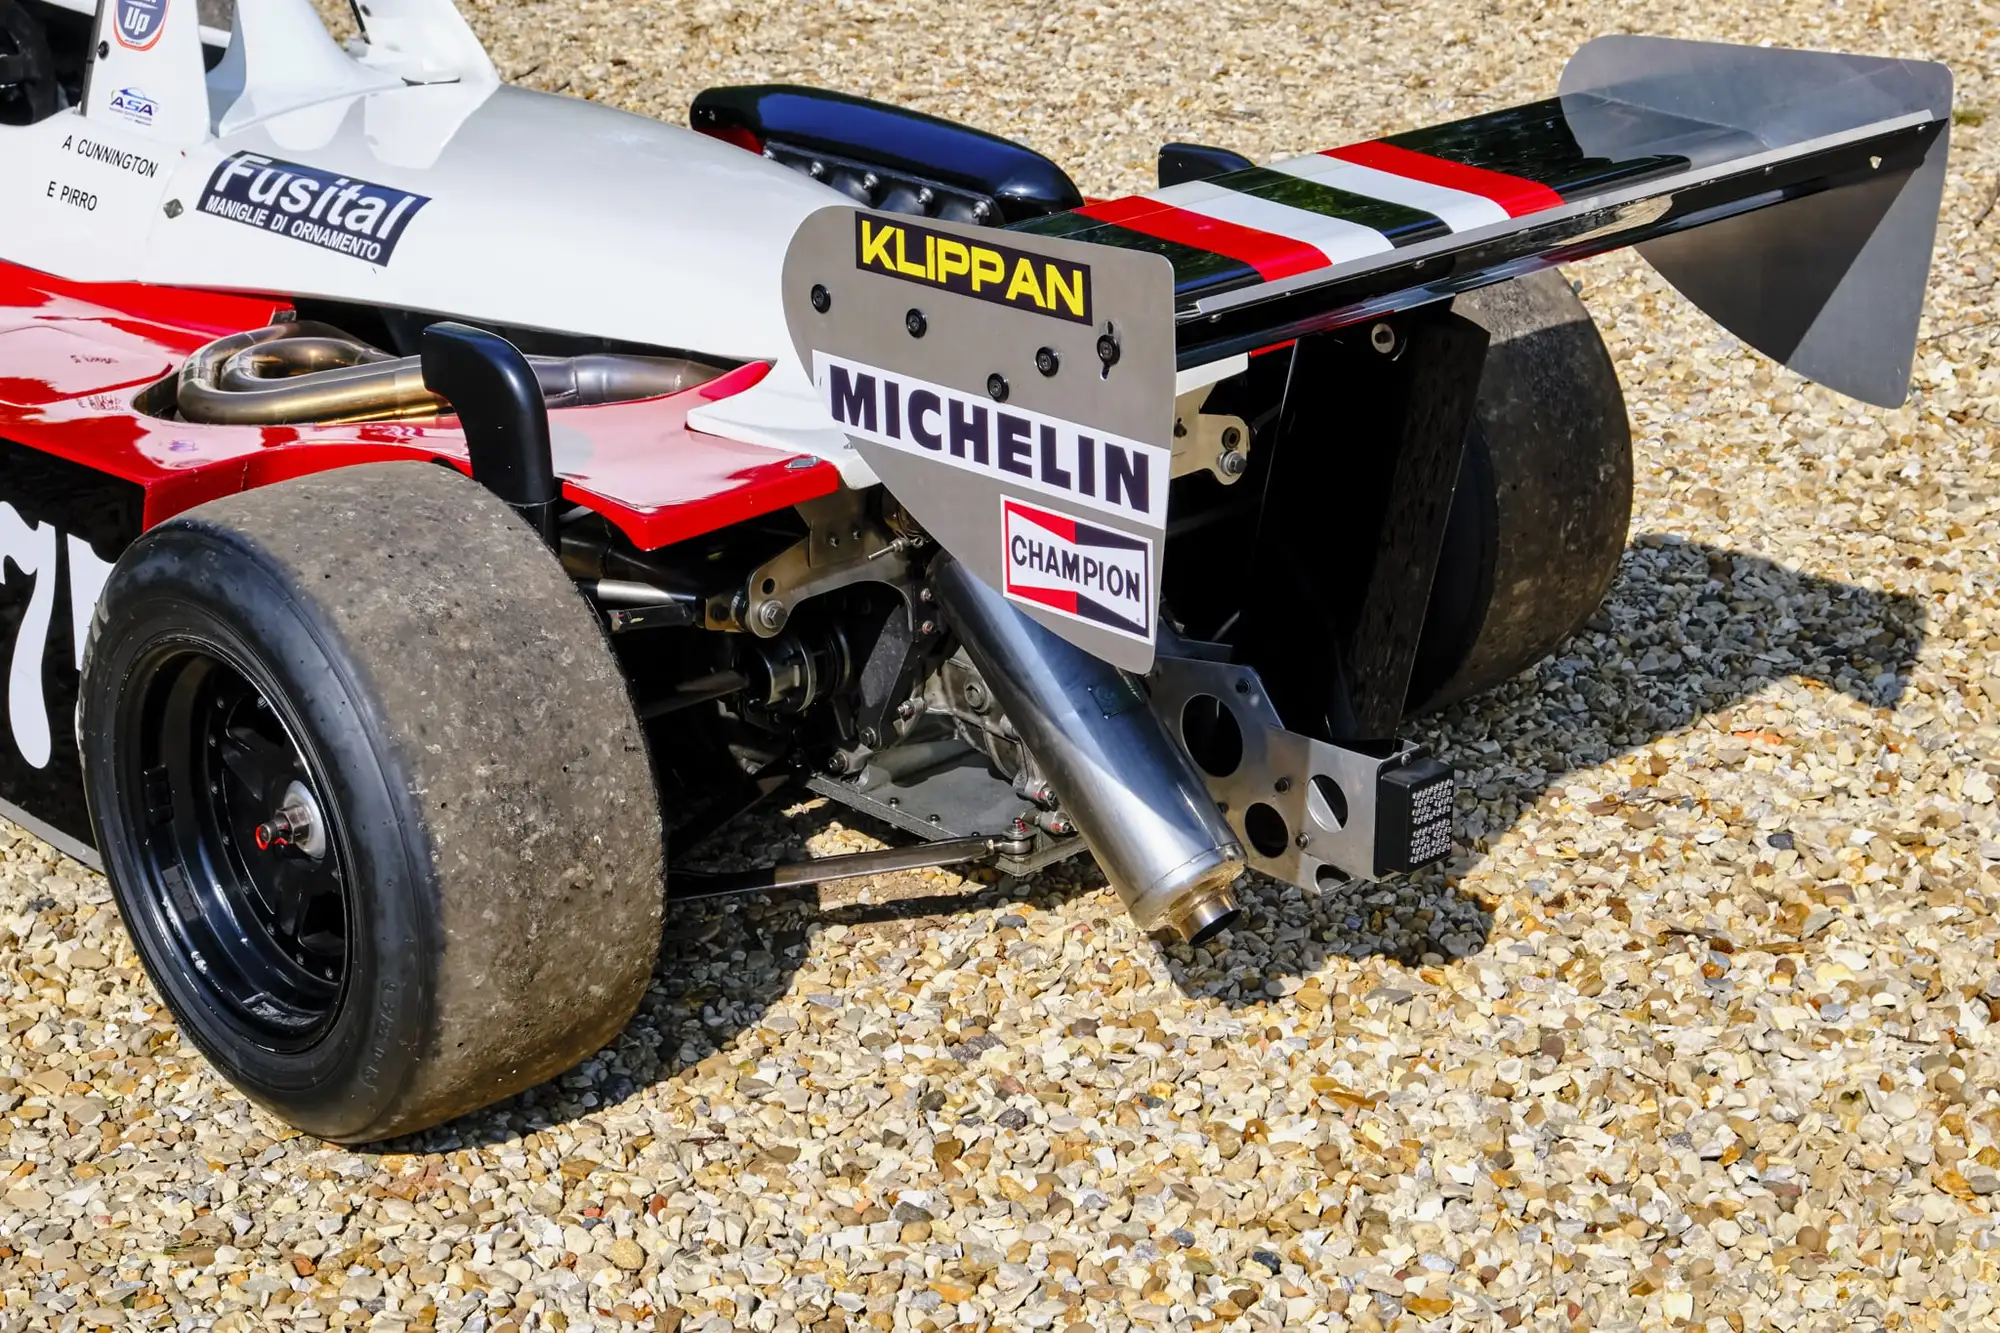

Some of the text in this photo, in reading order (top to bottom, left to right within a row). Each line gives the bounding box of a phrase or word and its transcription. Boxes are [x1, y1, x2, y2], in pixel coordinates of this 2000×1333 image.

[124, 6, 151, 36] Up
[110, 96, 153, 116] ASA
[61, 134, 159, 178] A CUNNINGTON
[47, 180, 98, 211] E PIRRO
[205, 194, 381, 261] MANIGLIE DI ORNAMENTO
[214, 153, 416, 240] Fusital
[860, 219, 1084, 318] KLIPPAN
[829, 364, 1150, 514] MICHELIN
[1011, 534, 1140, 603] CHAMPION
